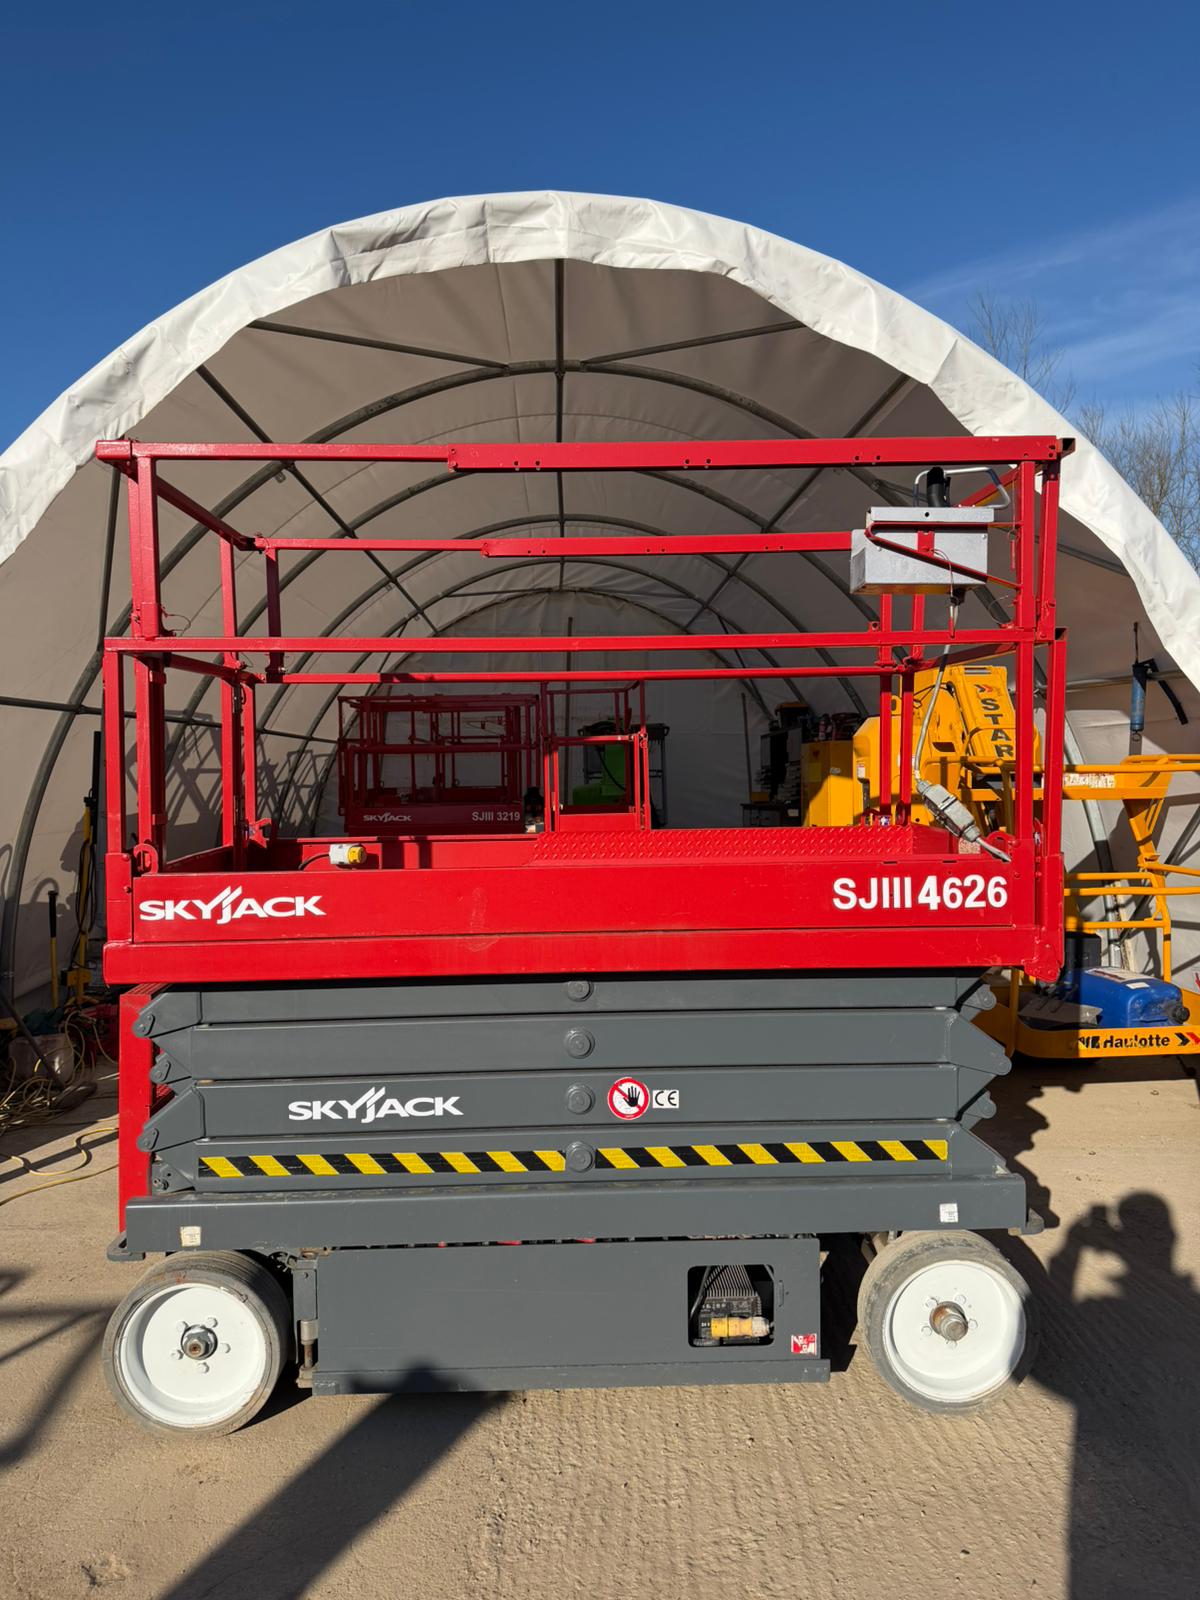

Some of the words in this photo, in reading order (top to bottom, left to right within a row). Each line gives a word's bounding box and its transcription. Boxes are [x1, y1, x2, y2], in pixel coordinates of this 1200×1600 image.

[981, 698, 1014, 758] STAR
[363, 812, 412, 823] SKYJACK
[471, 812, 494, 821] SJIII
[497, 811, 521, 821] 3219
[138, 885, 327, 925] SKYJACK
[832, 877, 912, 910] SJIII
[917, 874, 1008, 911] 4626
[287, 1086, 464, 1124] SKYJACK
[654, 1090, 678, 1107] CE
